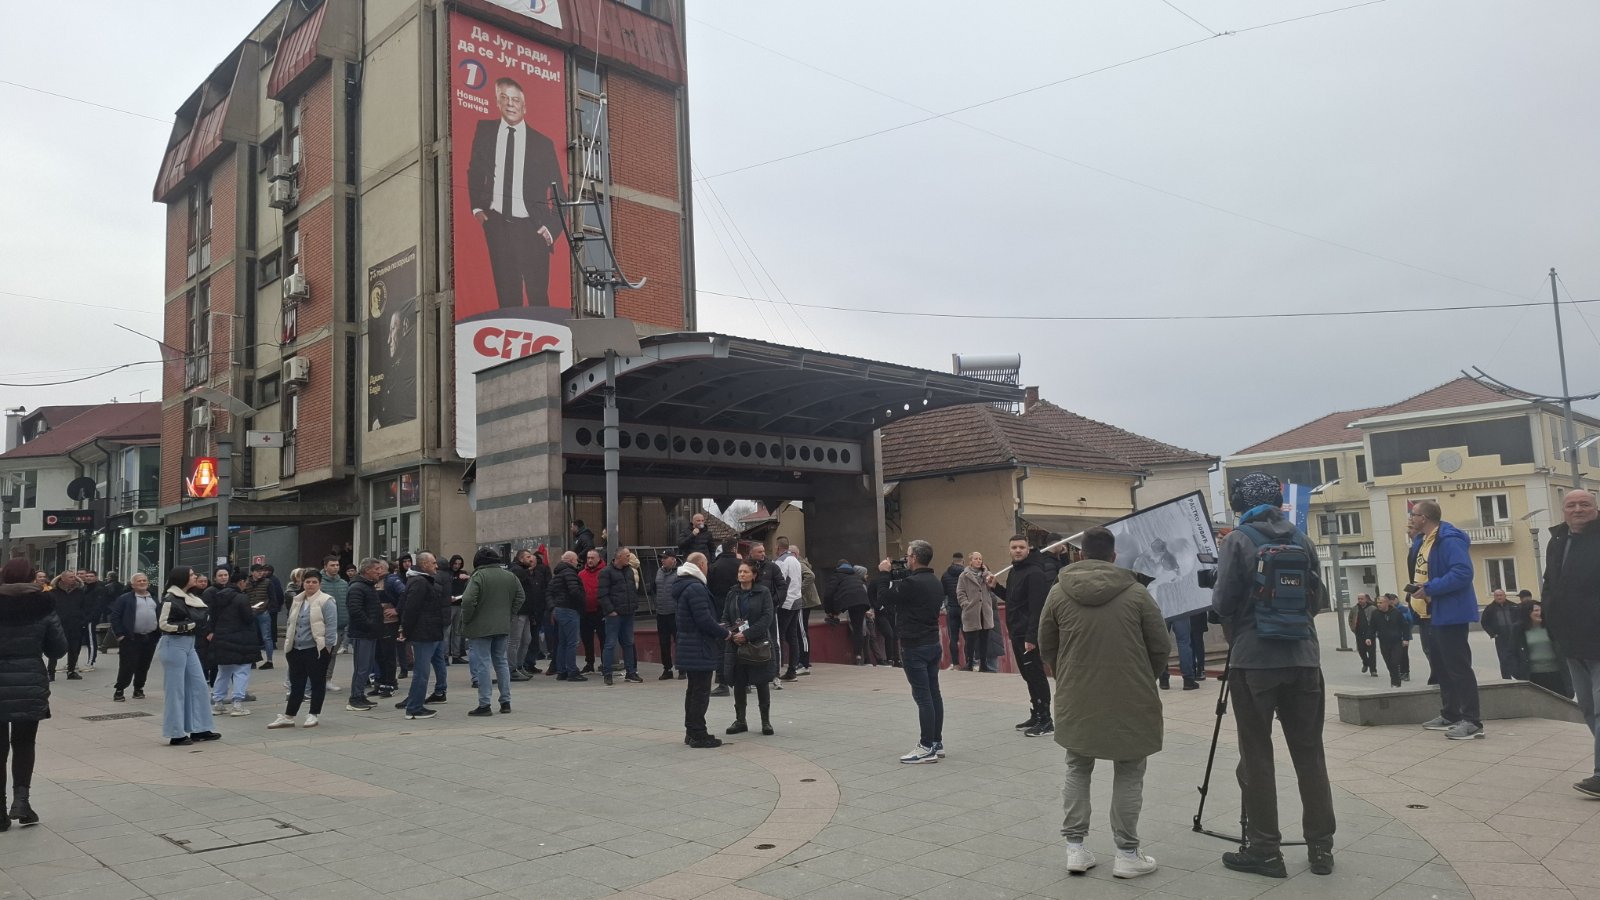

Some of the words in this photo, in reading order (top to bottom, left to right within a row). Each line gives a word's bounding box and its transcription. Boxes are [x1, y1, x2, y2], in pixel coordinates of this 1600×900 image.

[471, 26, 489, 42] Да
[493, 34, 514, 51] Југ
[517, 44, 550, 66] ради,
[458, 39, 475, 53] да
[479, 47, 494, 59] се
[497, 52, 518, 68] Југ
[521, 61, 560, 82] гради!
[466, 63, 478, 86] 1
[456, 88, 489, 106] Новица
[457, 98, 489, 114] Тончев
[1405, 485, 1443, 494] ОПШТИНА
[1456, 480, 1506, 491] СУРДУЛИЦА
[1188, 498, 1200, 522] РАСТКО
